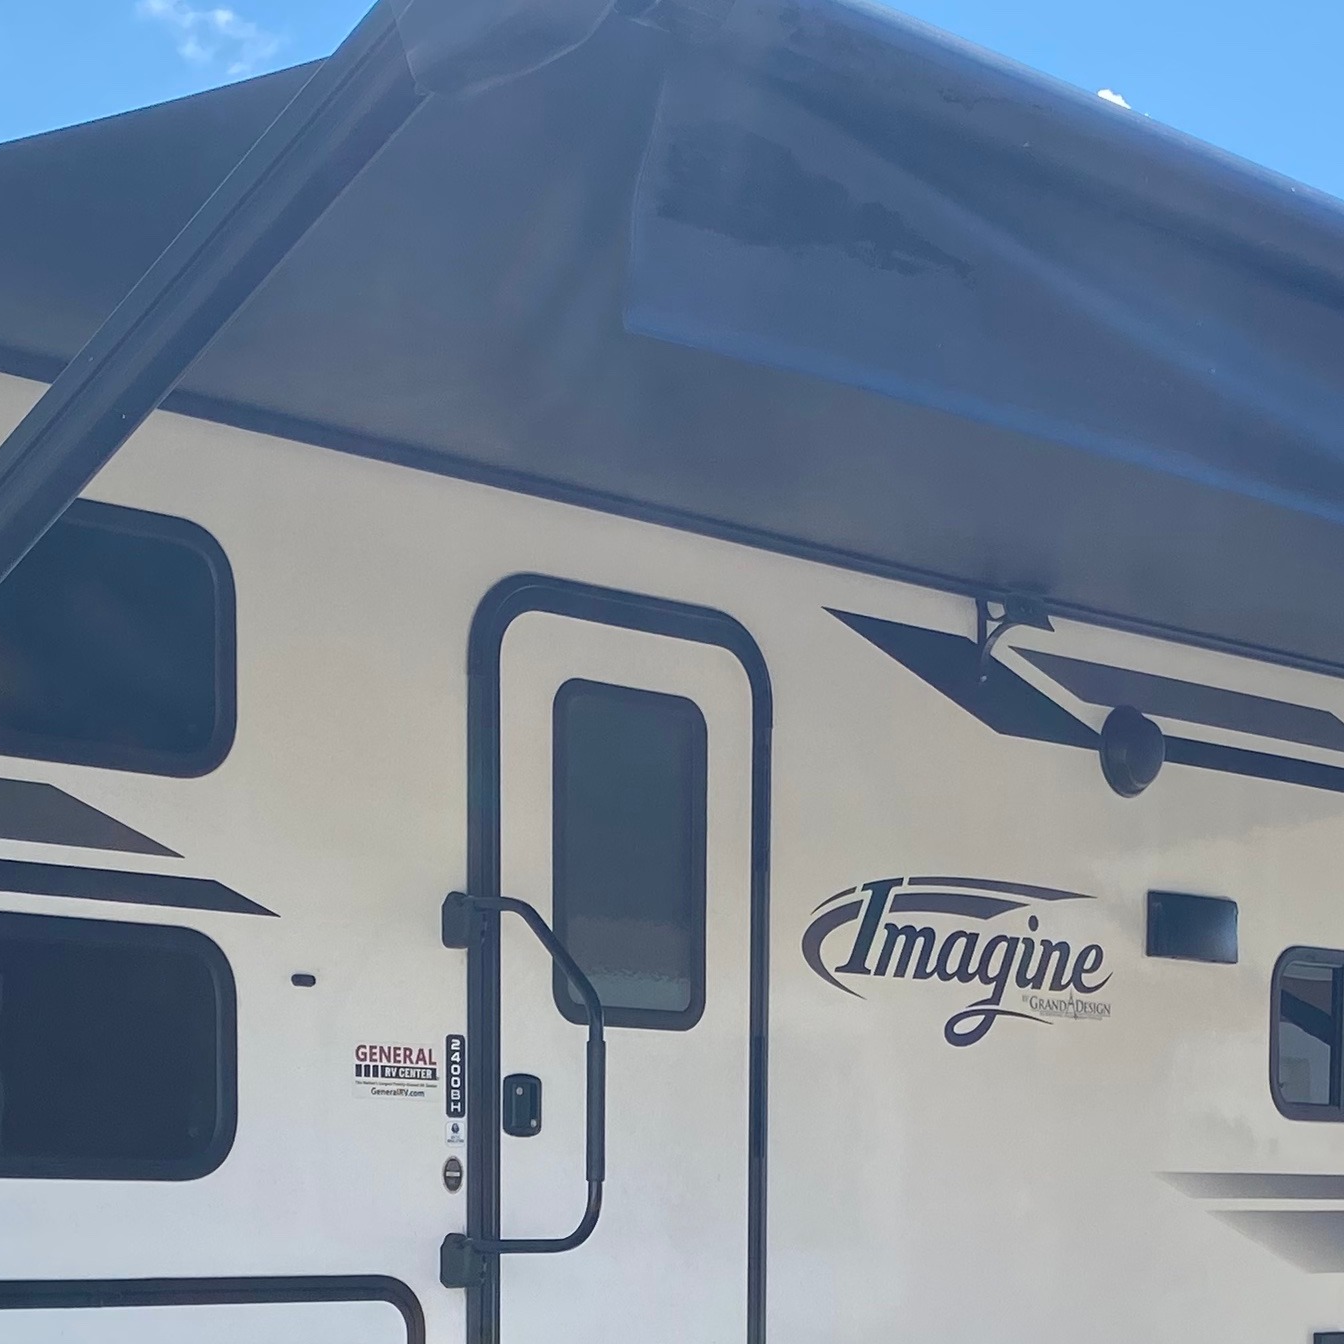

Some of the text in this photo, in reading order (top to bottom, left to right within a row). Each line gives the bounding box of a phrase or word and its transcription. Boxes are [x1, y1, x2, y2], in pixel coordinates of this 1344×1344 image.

[834, 876, 1114, 1047] Imagine
[1029, 996, 1067, 1011] GRAND
[1076, 999, 1111, 1015] DESIGN
[355, 1044, 437, 1066] GENERAL
[384, 1066, 433, 1079] RV CENTER
[450, 1038, 461, 1113] 2400BH
